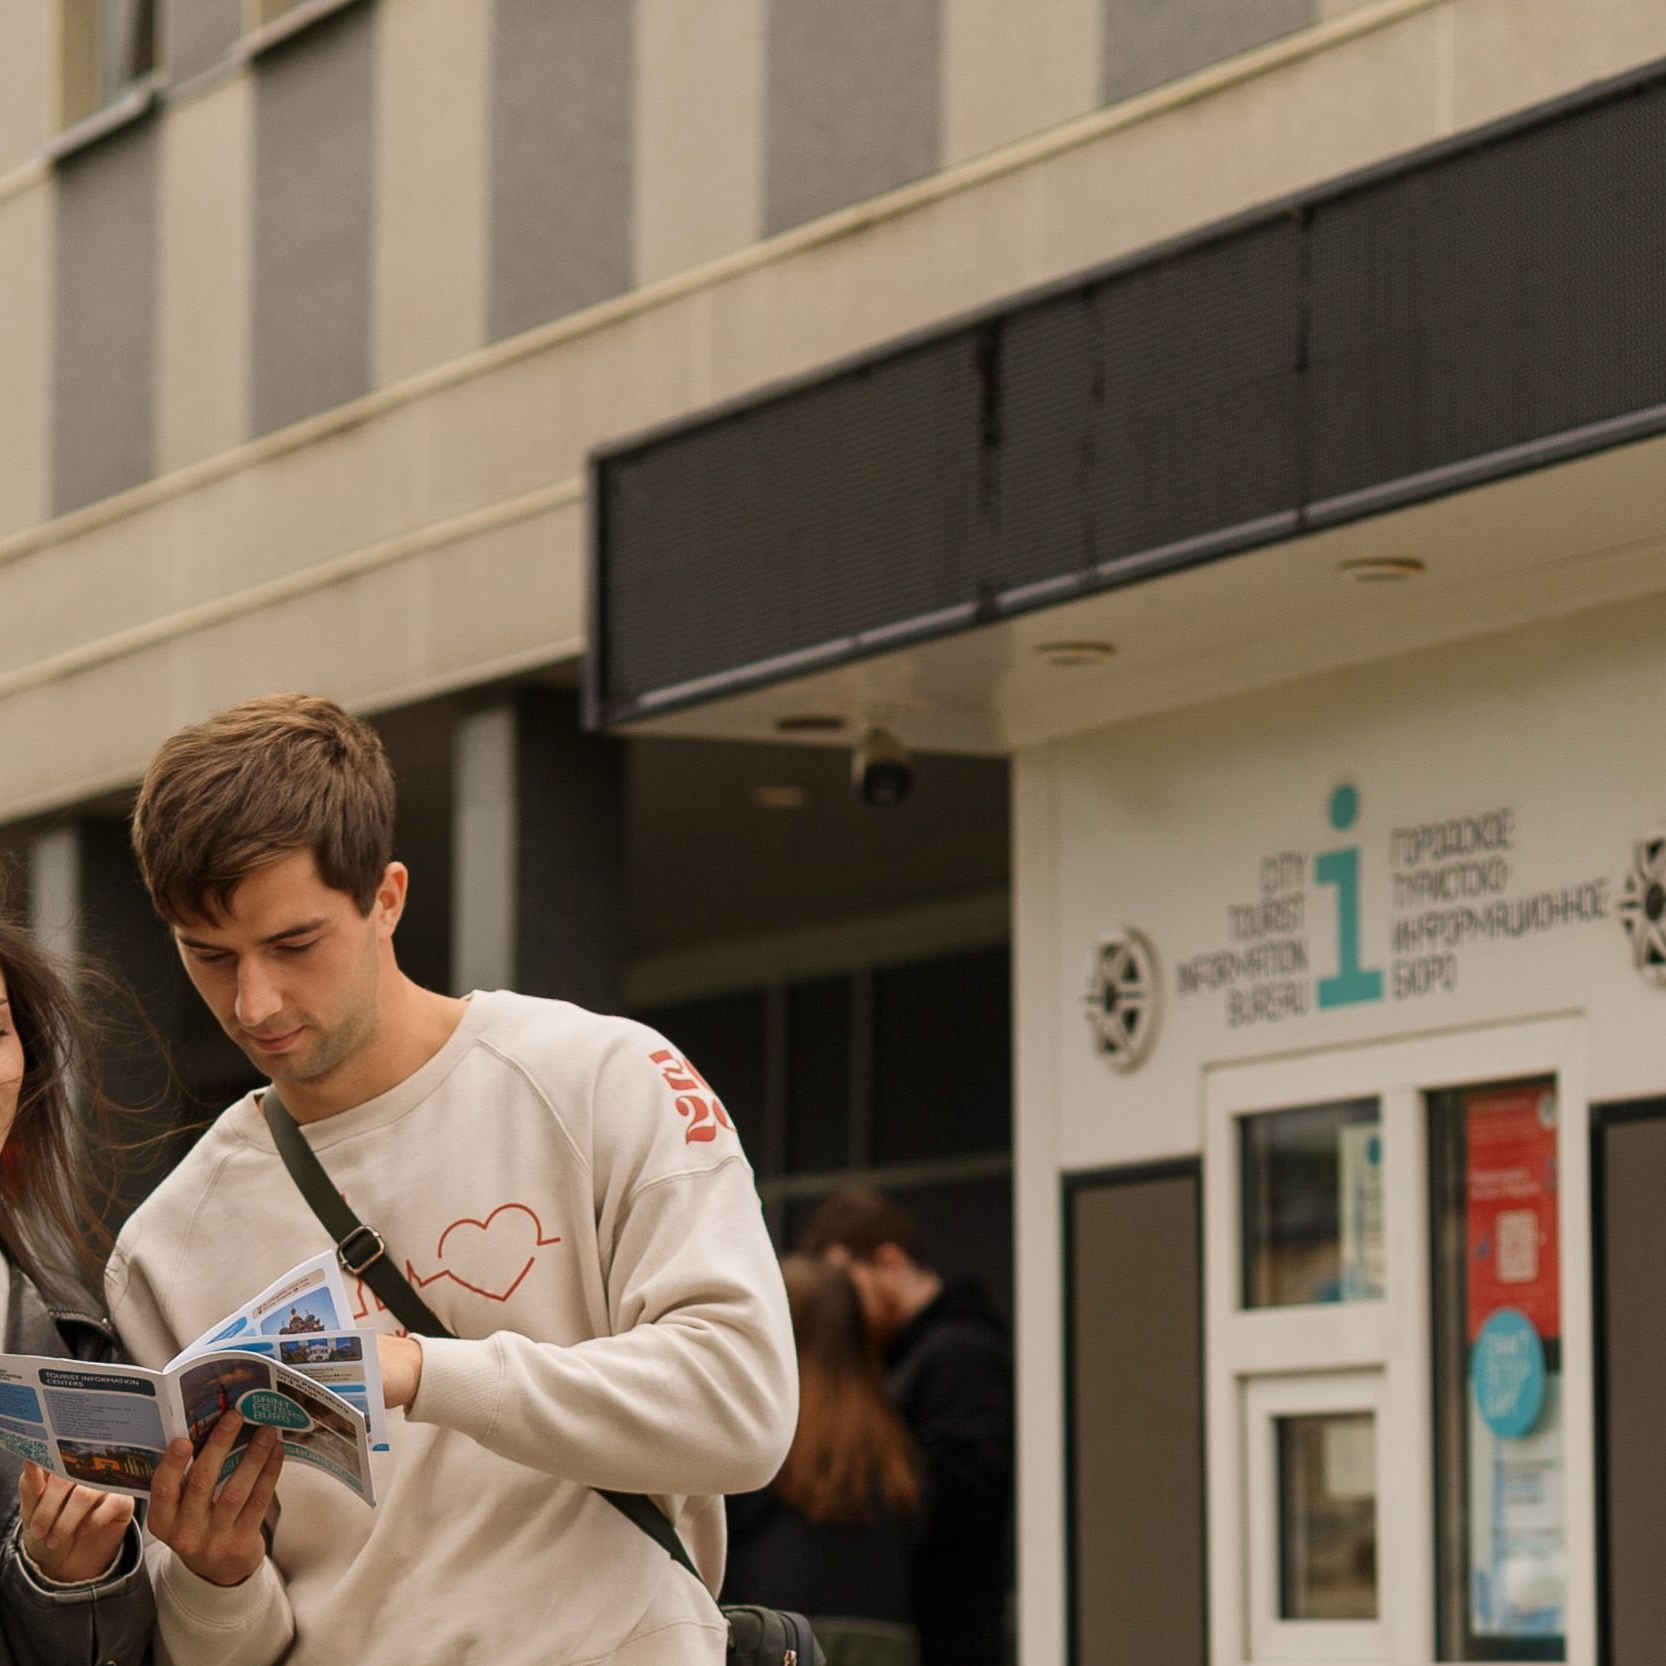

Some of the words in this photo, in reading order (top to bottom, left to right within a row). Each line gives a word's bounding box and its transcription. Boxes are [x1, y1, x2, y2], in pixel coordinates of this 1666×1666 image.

[45, 1372, 79, 1381] TOURIST
[81, 1376, 140, 1387] INFORMATION
[46, 1379, 84, 1387] CENTERS
[253, 1394, 290, 1406] SAINT
[253, 1411, 290, 1424] BURG
